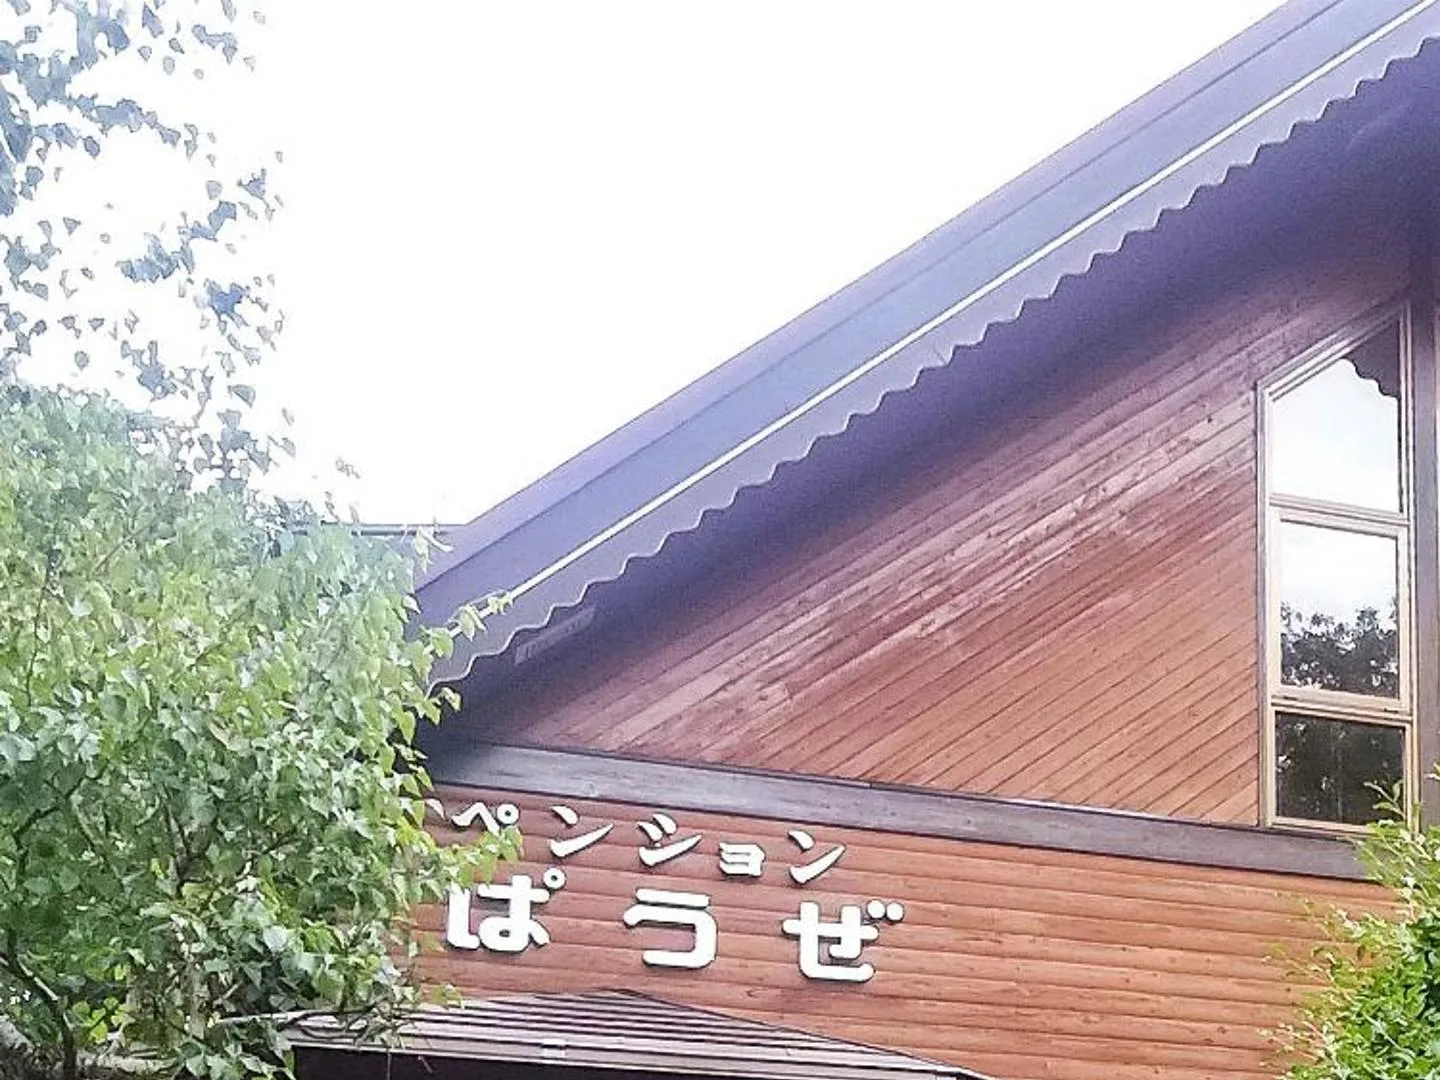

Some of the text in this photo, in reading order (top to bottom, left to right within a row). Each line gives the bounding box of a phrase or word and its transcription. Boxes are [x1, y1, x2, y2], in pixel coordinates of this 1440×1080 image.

[450, 801, 847, 884] ペンション
[446, 866, 904, 983] ぱうぜ
